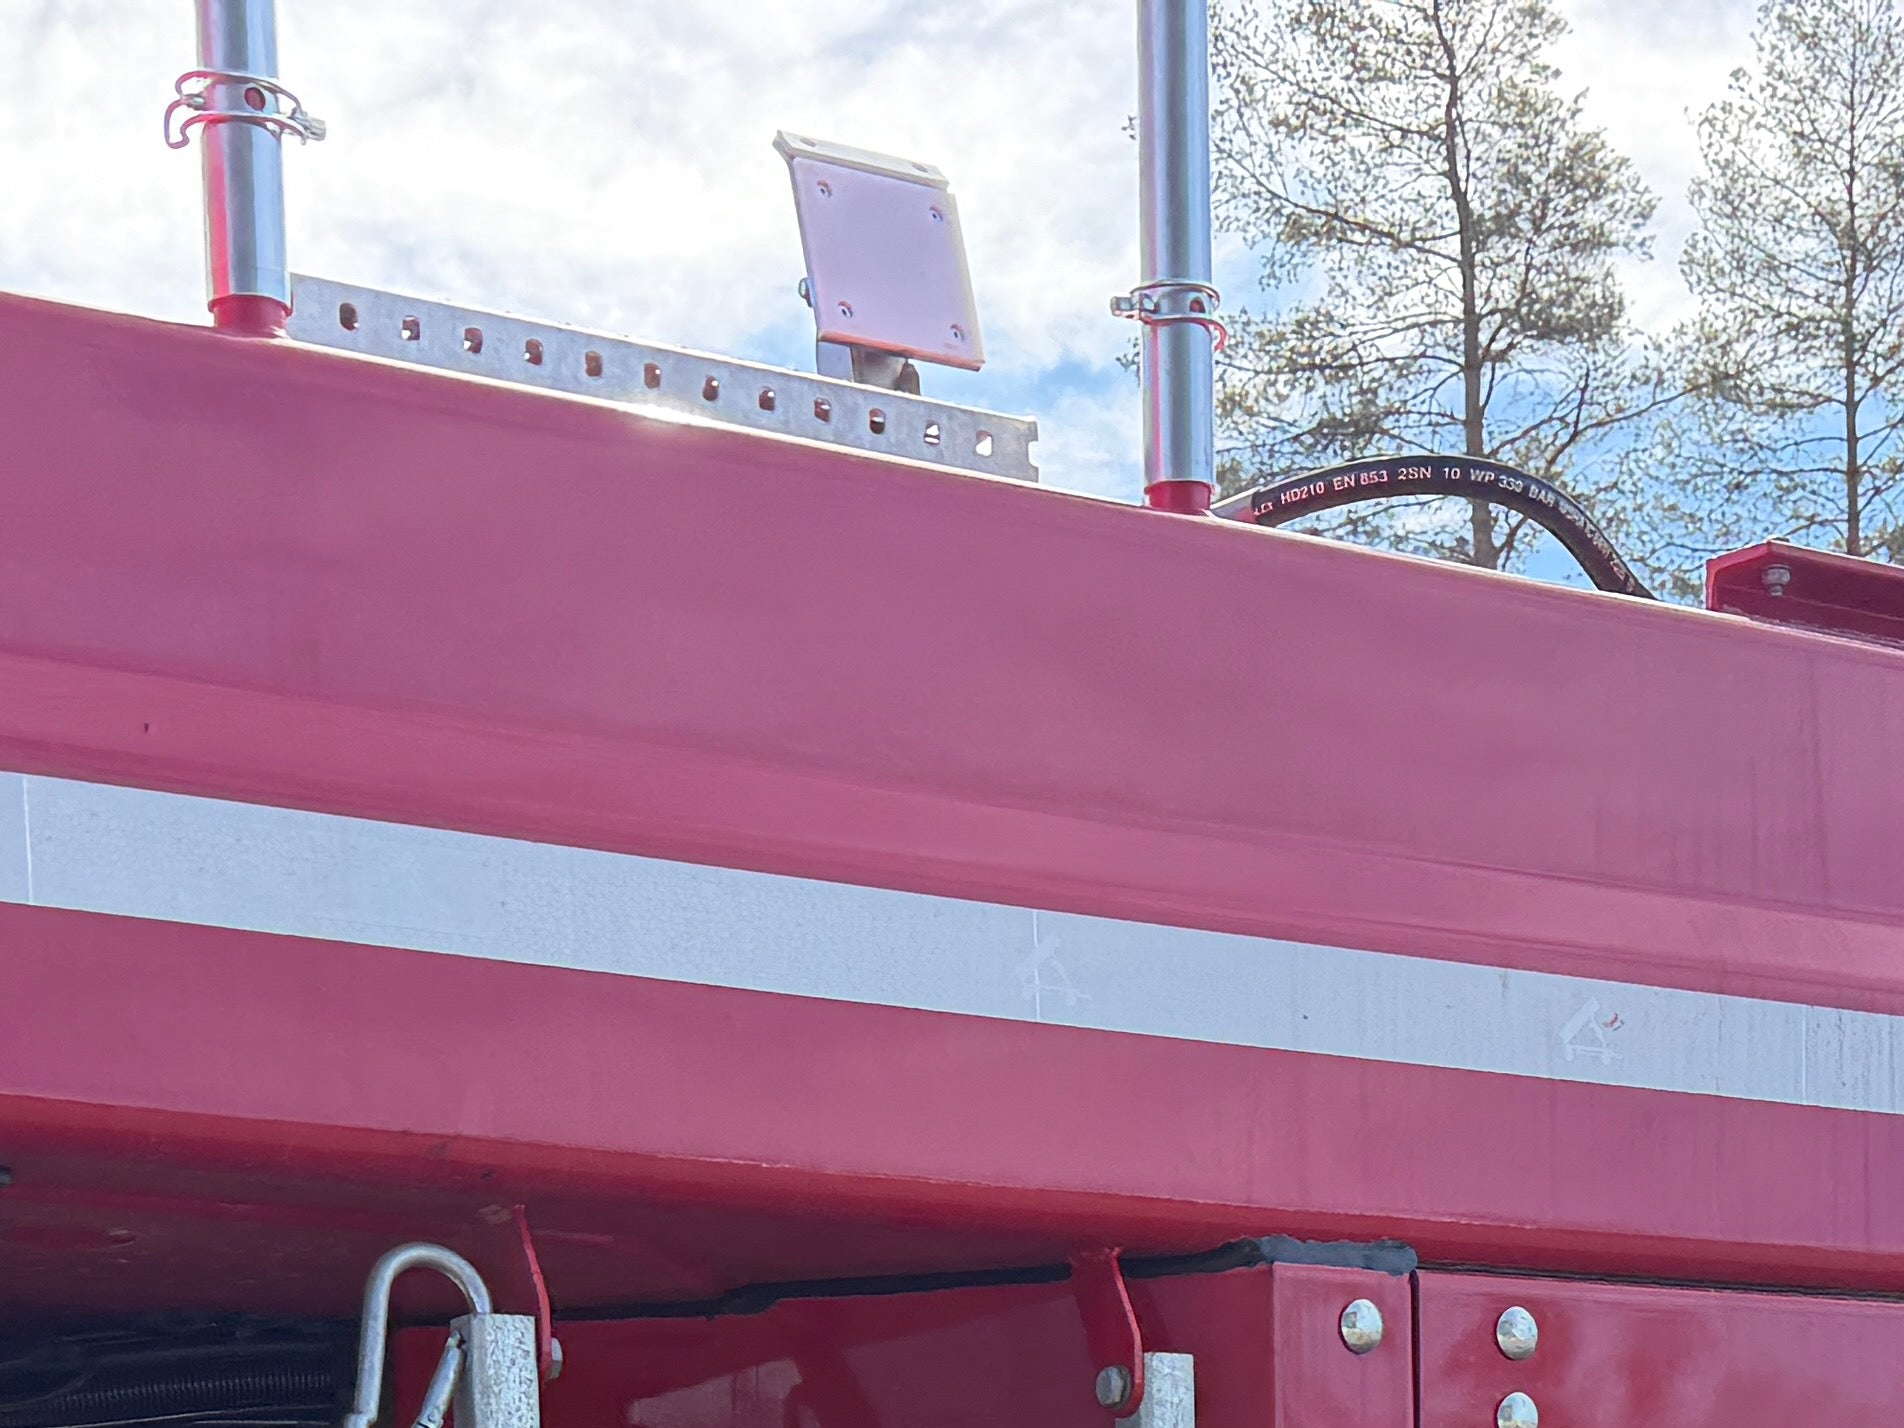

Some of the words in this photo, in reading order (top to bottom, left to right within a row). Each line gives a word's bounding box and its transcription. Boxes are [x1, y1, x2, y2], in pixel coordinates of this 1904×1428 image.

[1280, 481, 1325, 505] HD210
[1333, 474, 1355, 491] EN
[1360, 470, 1388, 485] 853
[1397, 465, 1432, 480] 2SN
[1443, 467, 1461, 479] 10
[1470, 468, 1495, 483] WP
